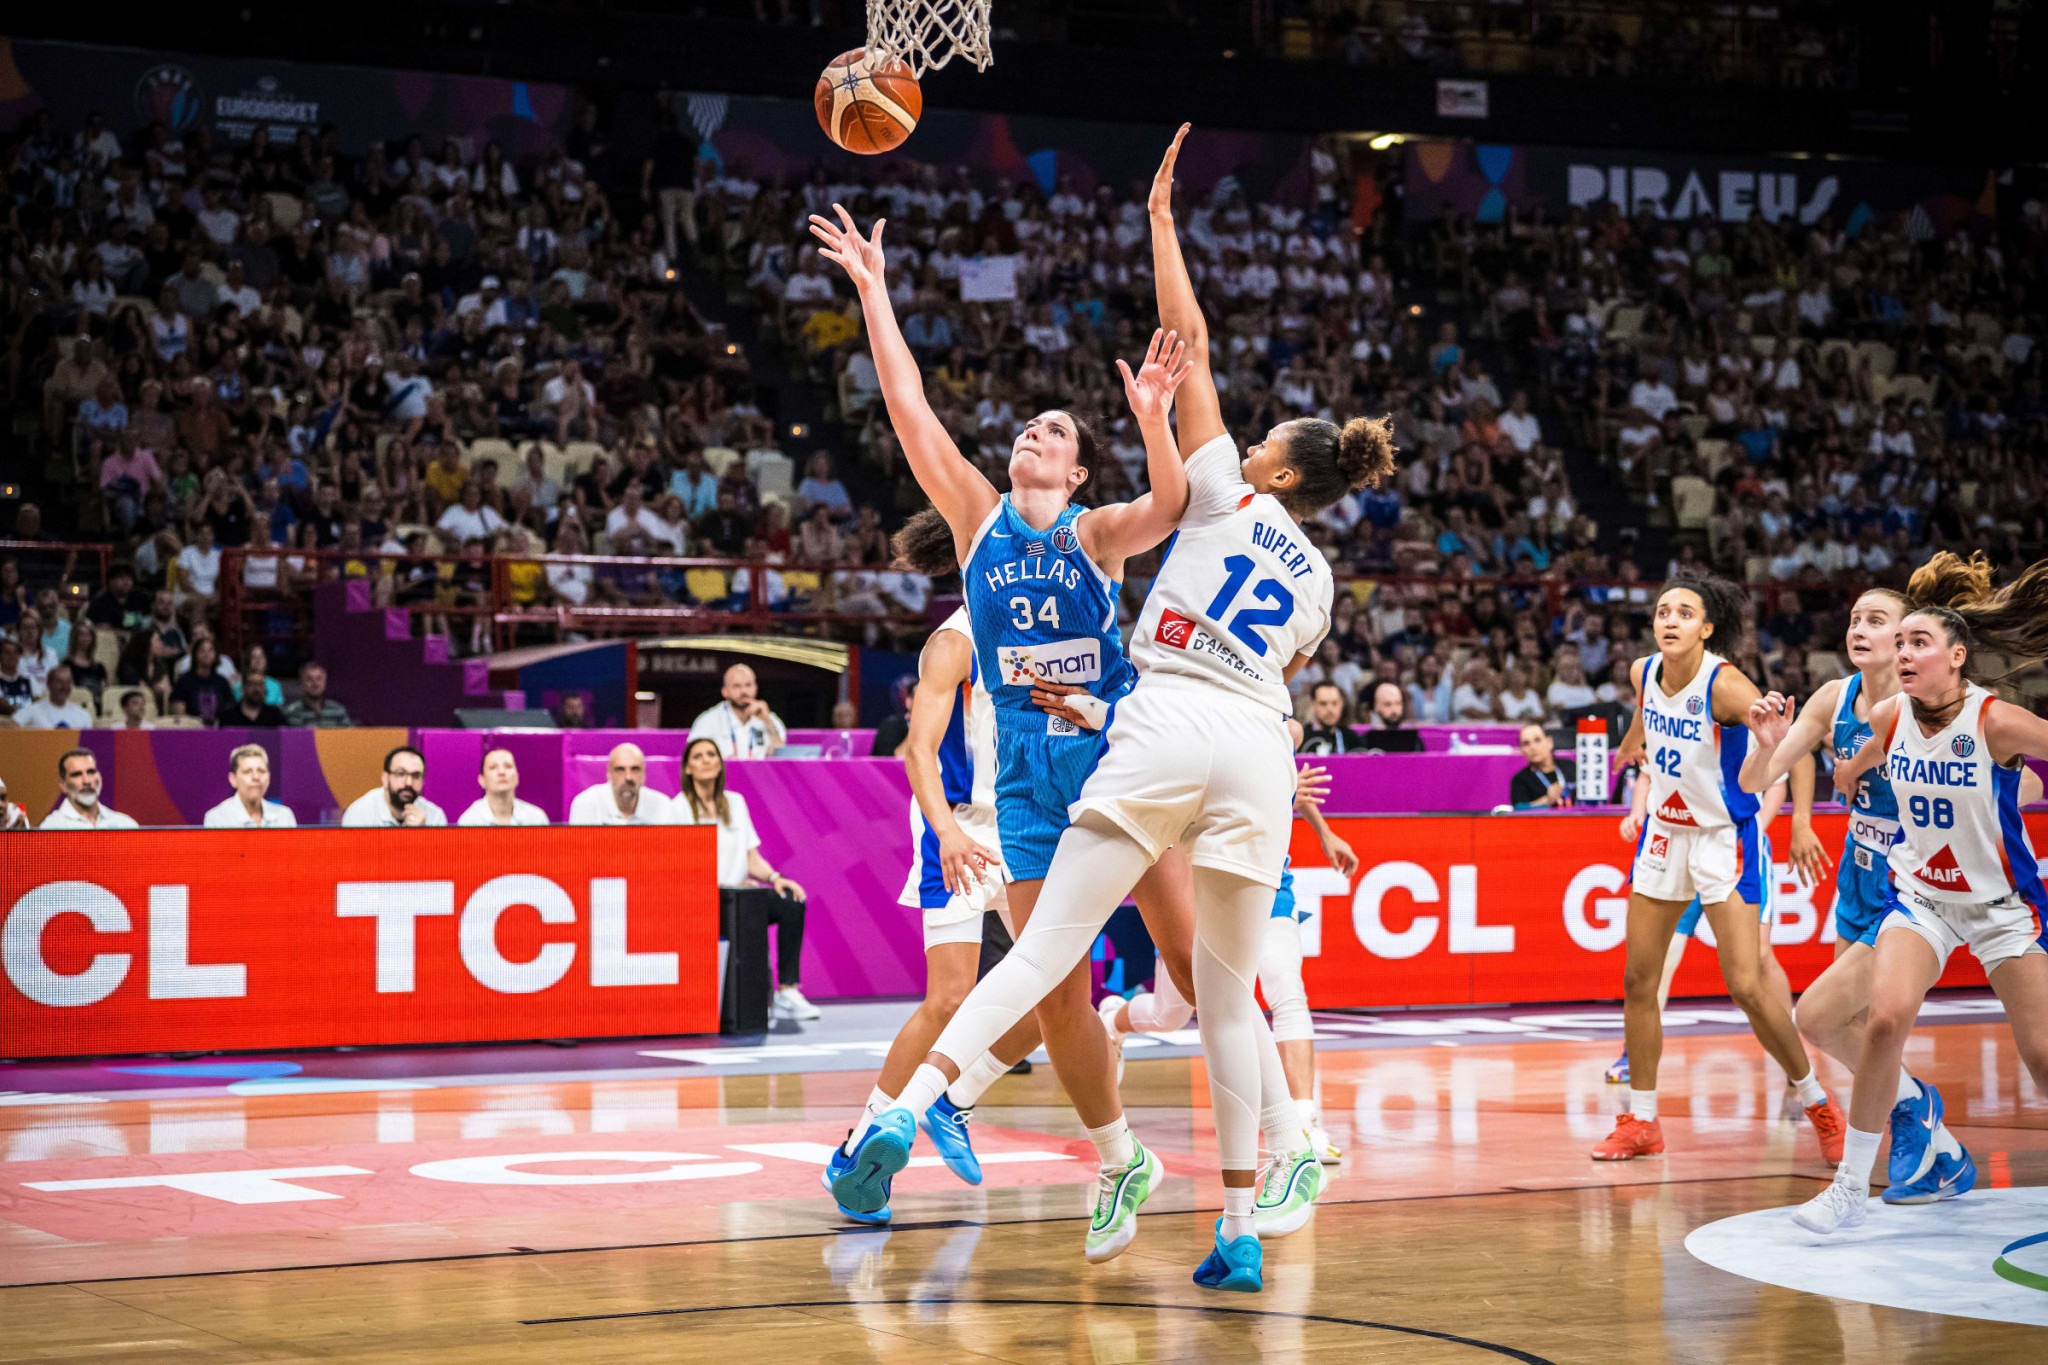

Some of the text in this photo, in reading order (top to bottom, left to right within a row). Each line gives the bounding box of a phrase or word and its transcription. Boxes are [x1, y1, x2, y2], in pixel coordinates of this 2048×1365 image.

[1567, 163, 1841, 226] PIRAEUS
[1251, 521, 1313, 579] RUPERT
[985, 556, 1081, 592] HELLAS
[1009, 595, 1060, 631] 34
[1205, 554, 1295, 658] 12
[1643, 706, 1702, 742] FRANCE
[1655, 745, 1682, 778] 42
[1890, 753, 1978, 787] FRANCE
[1658, 805, 1693, 822] MAIF
[1909, 795, 1955, 829] 98
[1920, 866, 1963, 883] MAIF
[1298, 860, 1516, 960] TCL
[335, 873, 680, 994] TCL
